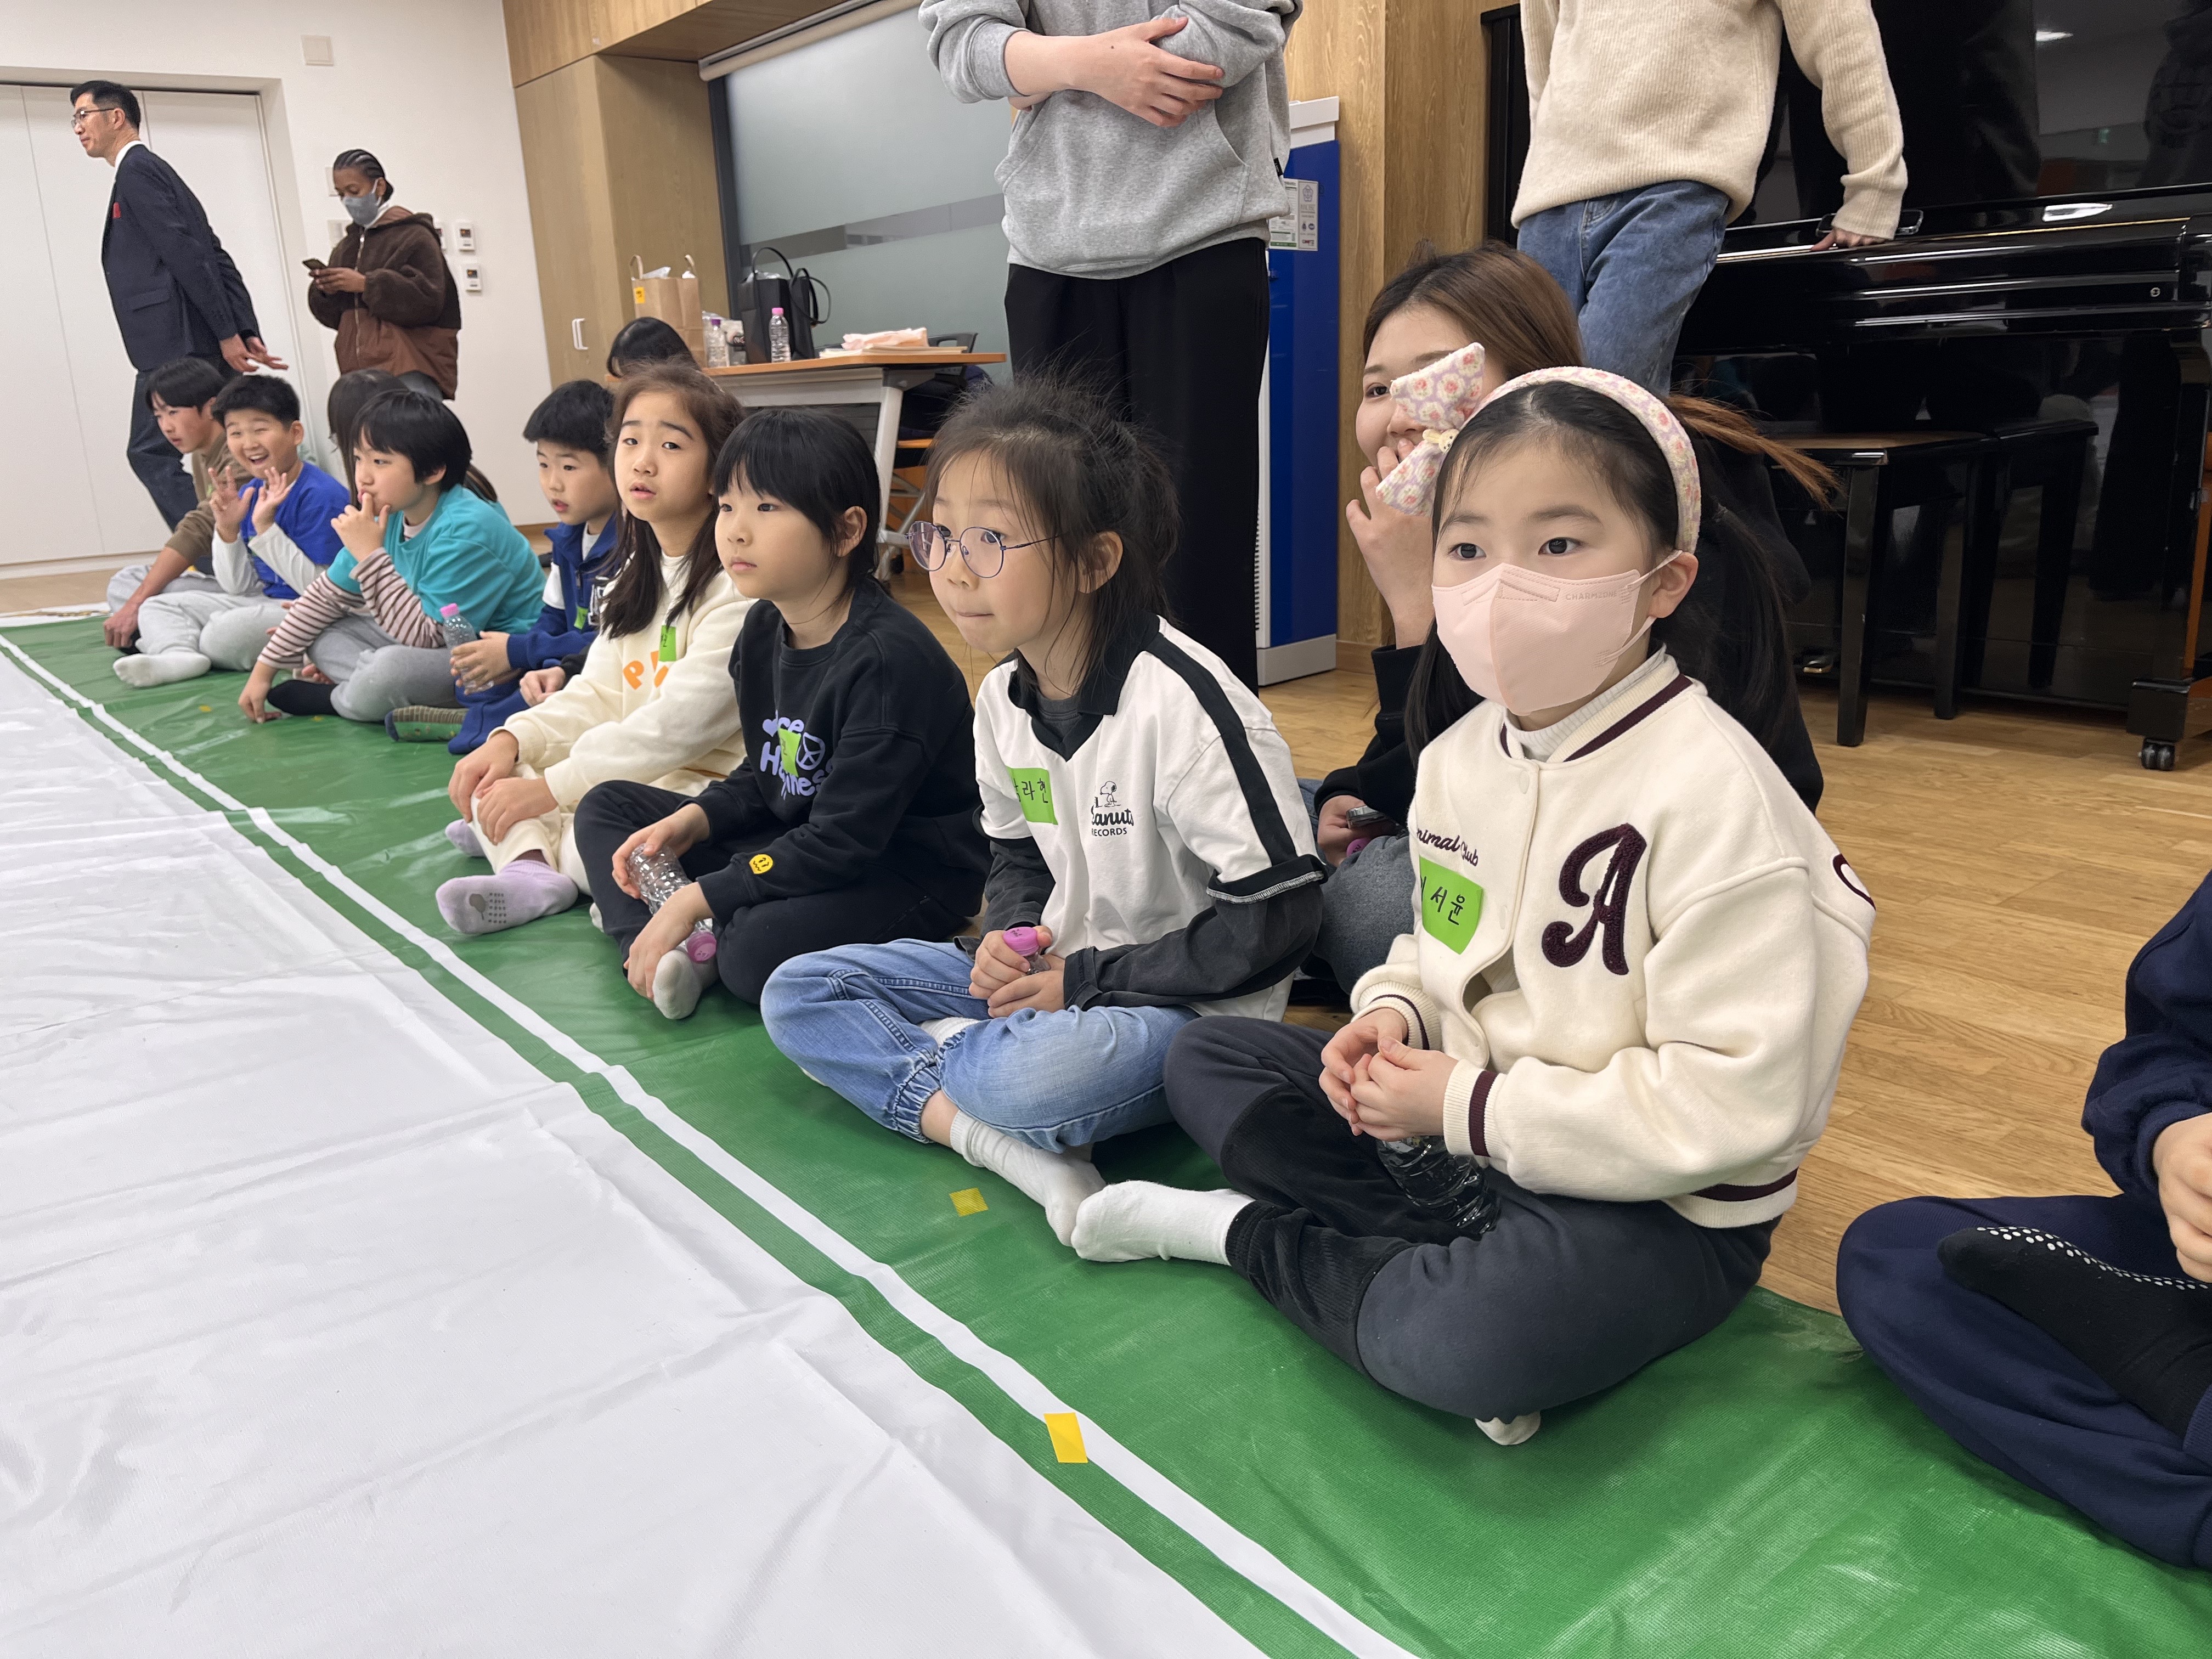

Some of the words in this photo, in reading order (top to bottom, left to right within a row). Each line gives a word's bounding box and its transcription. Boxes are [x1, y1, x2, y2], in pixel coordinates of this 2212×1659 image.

[1566, 592, 1617, 601] CHARMZONE
[1417, 827, 1460, 852] nimal
[1460, 841, 1479, 867] Club
[1542, 823, 1647, 975] A
